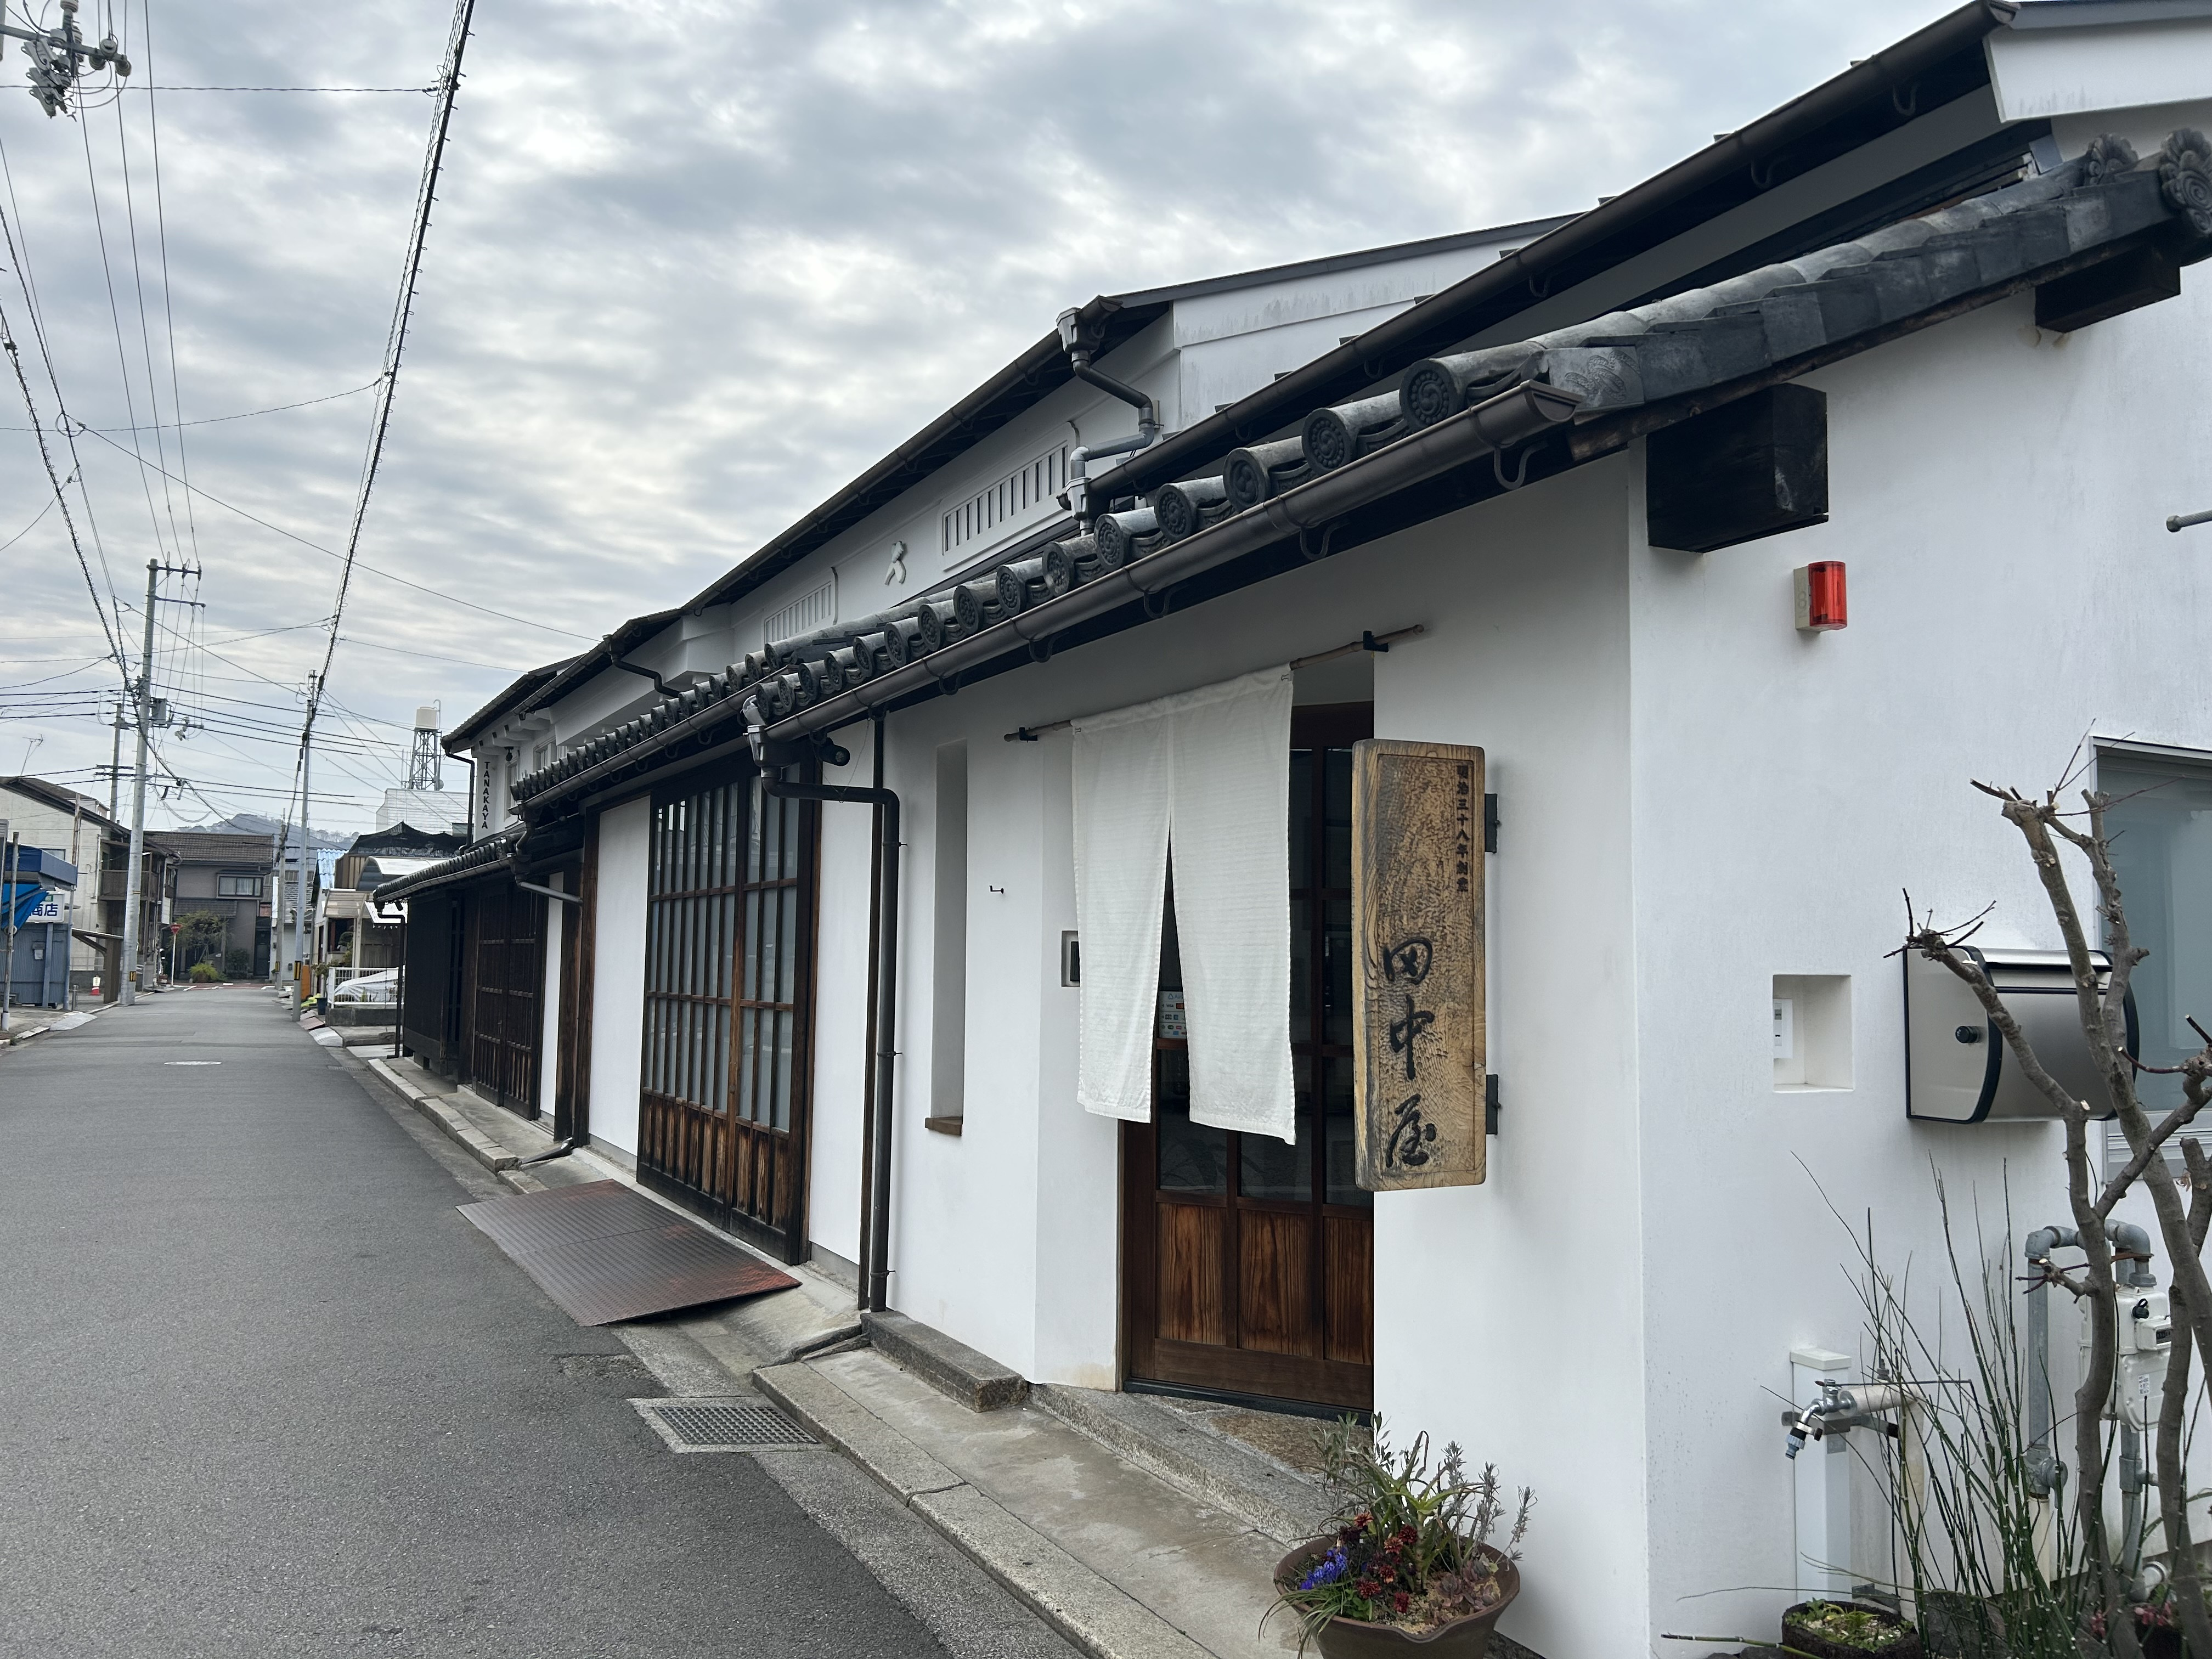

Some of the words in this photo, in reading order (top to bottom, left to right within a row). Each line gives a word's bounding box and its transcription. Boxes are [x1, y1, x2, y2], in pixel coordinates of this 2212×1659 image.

[482, 761, 490, 829] TANAKAYA
[1383, 936, 1436, 1167] 田中屋
